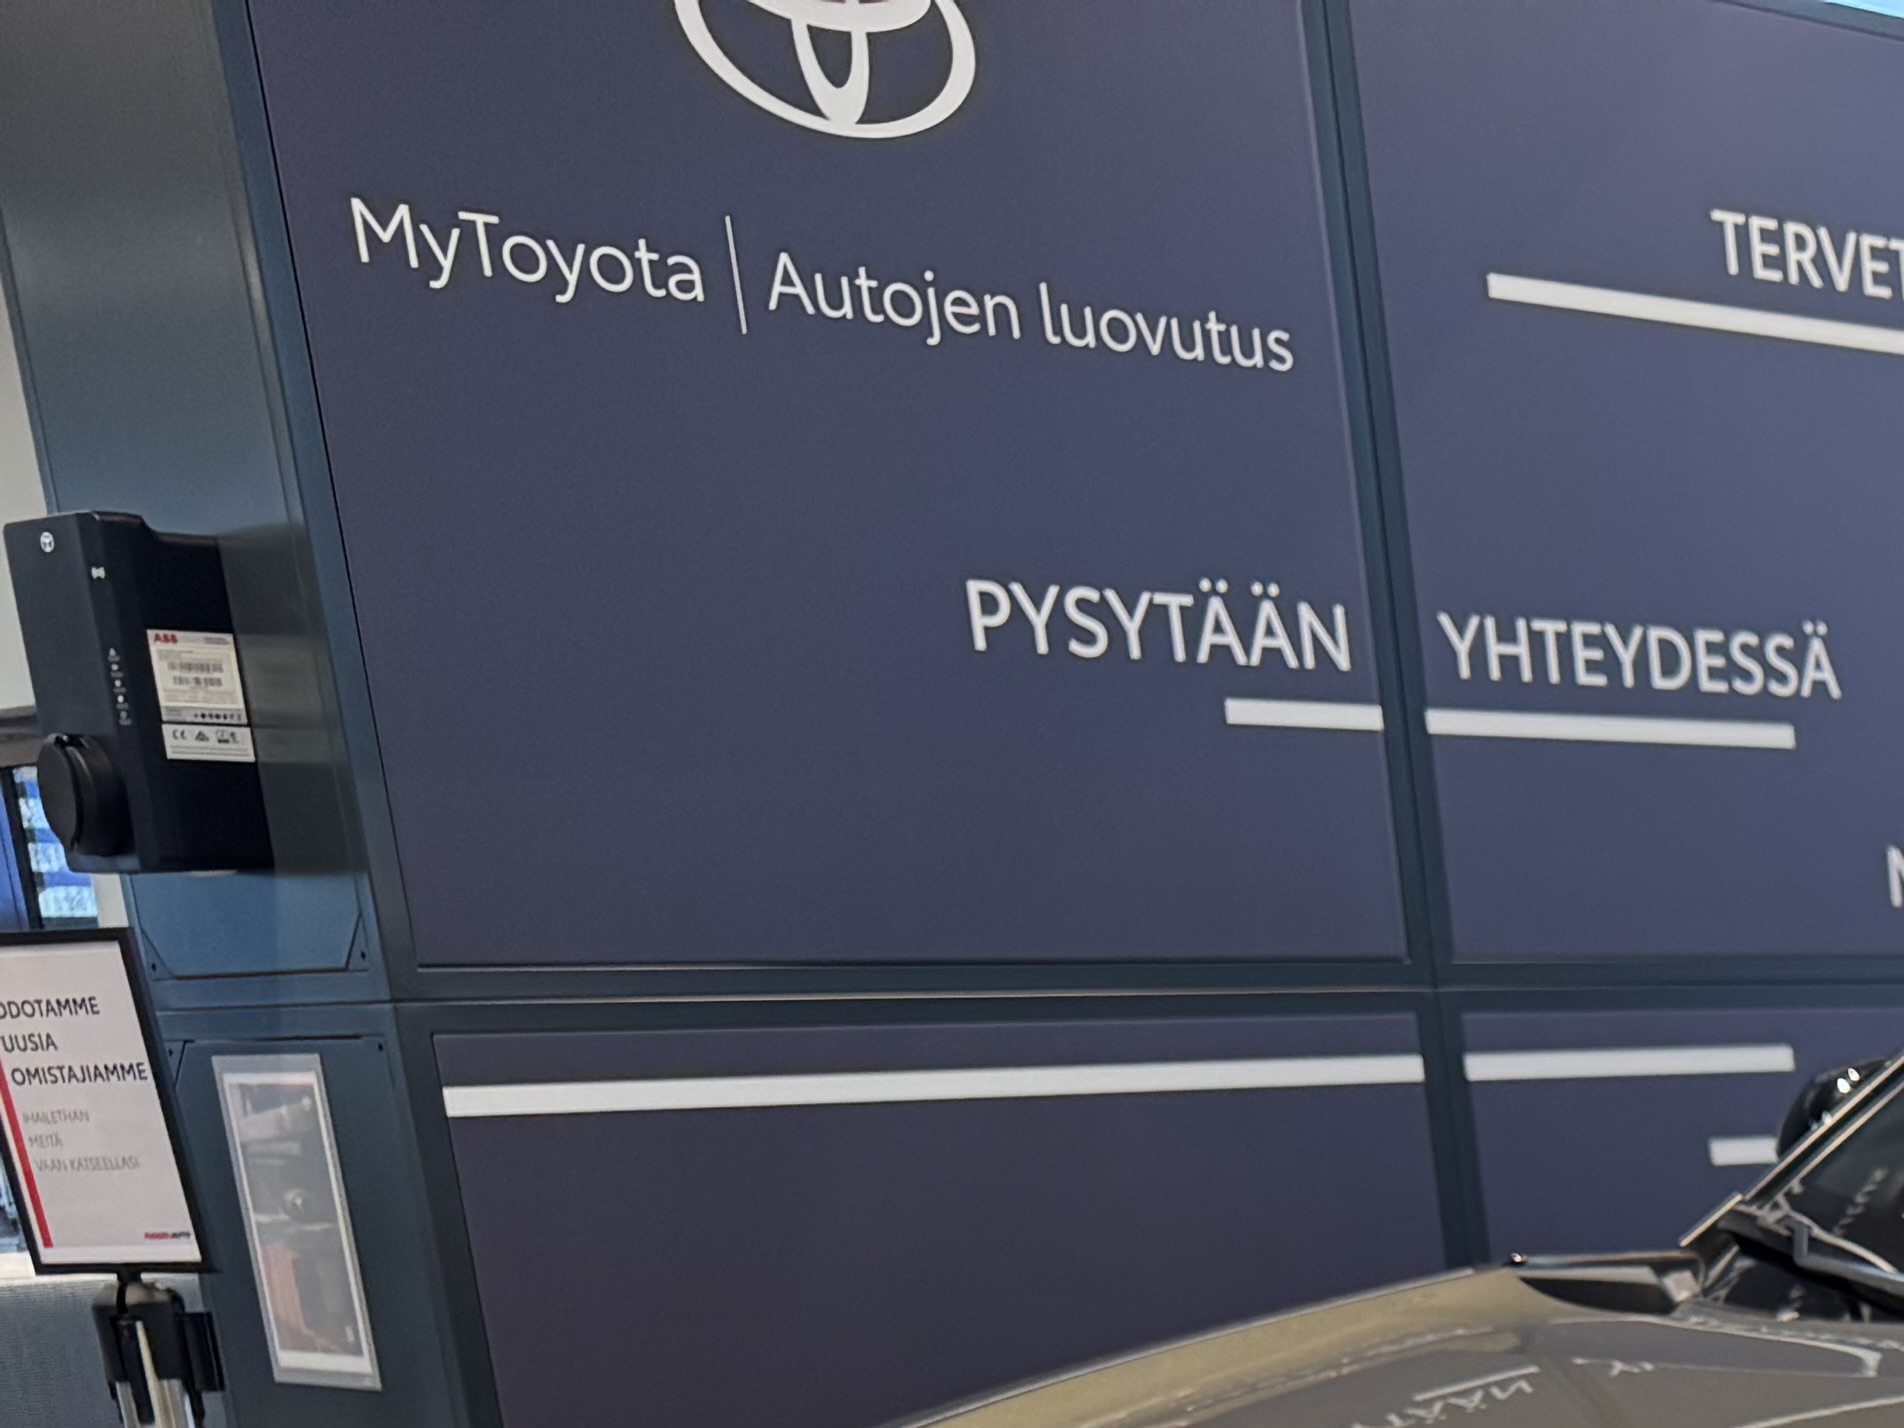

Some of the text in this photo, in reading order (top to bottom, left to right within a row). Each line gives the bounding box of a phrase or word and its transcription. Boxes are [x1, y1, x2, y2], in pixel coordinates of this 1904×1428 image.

[350, 196, 1295, 372] MyToyota Autojen luovutus
[154, 632, 178, 644] ABB
[965, 577, 1843, 701] PYSYTÄÄN YHTEYDESSÄ
[1, 1032, 58, 1053] UUSIA
[11, 1062, 149, 1086] OMISTAJIAMME
